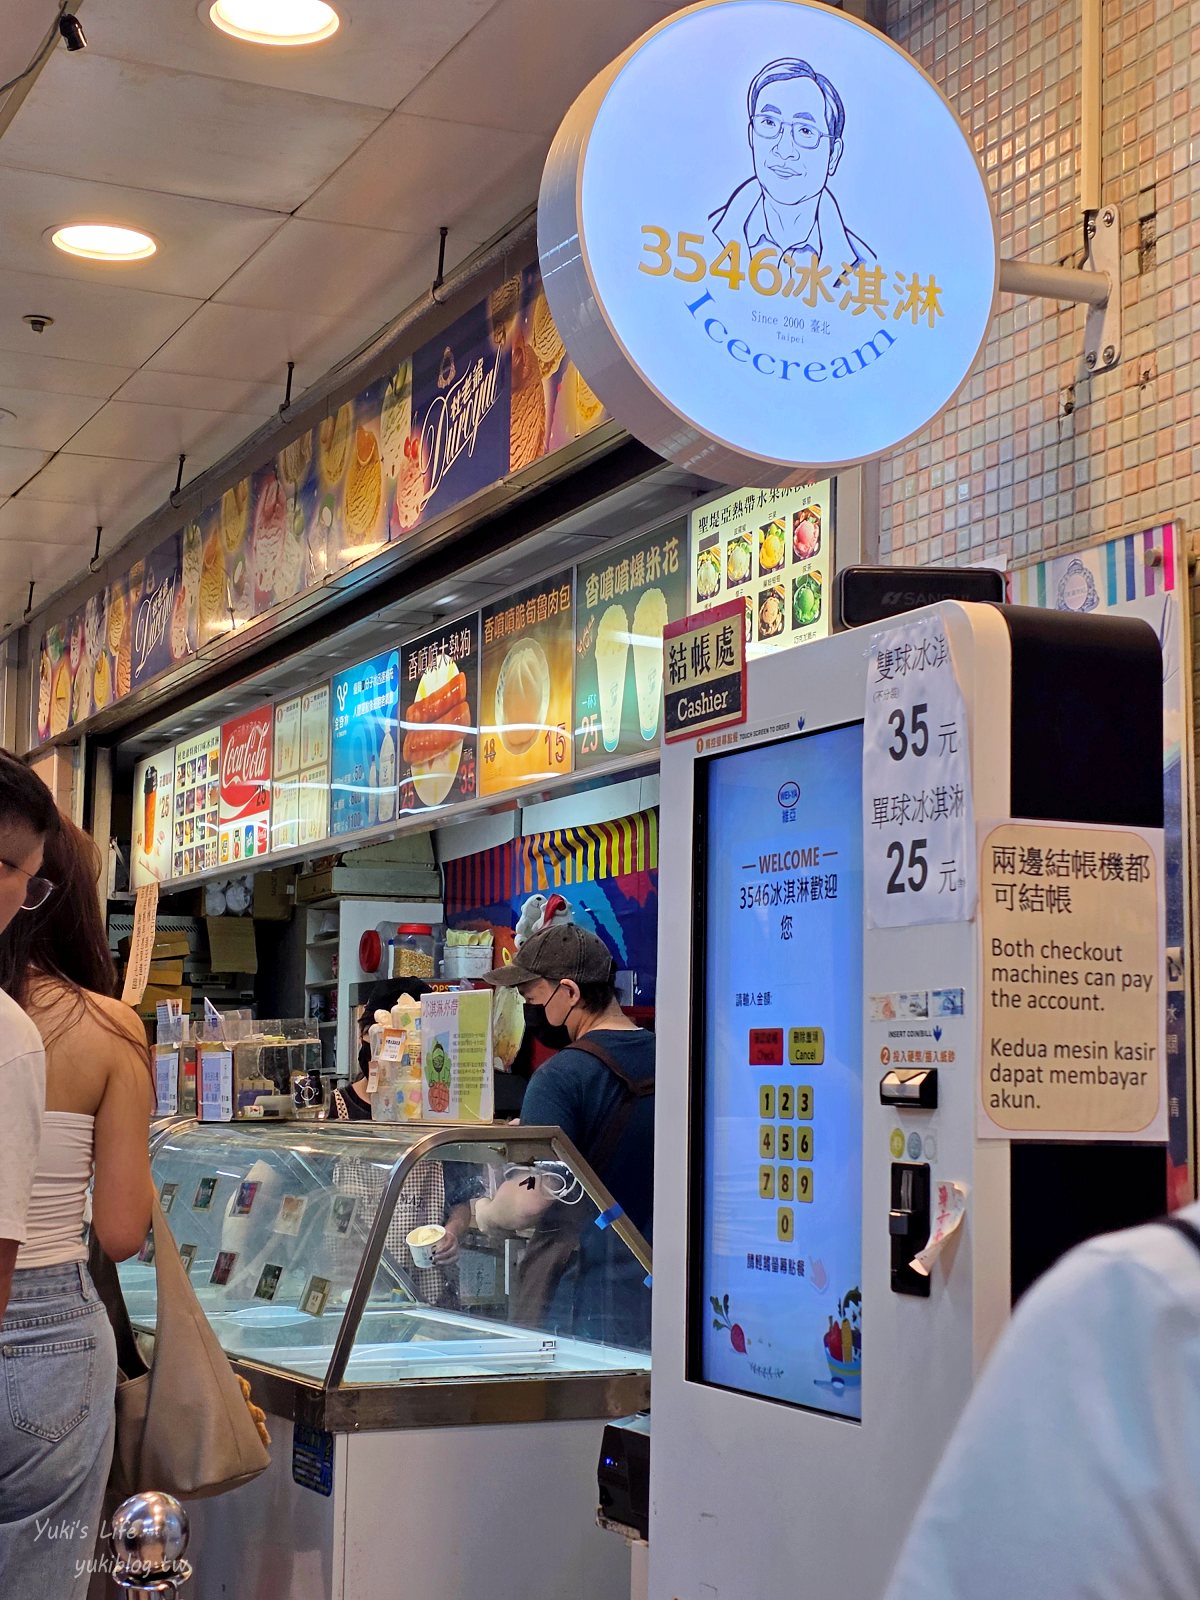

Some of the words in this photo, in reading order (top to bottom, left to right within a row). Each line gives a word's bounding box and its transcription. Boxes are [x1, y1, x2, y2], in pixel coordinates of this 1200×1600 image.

[638, 225, 944, 328] 3546冰淇淋
[751, 310, 778, 327] Since
[783, 315, 805, 331] 2000
[684, 288, 898, 383] Icecream
[776, 331, 805, 345] Taipei
[450, 357, 484, 422] 杜老爺
[585, 536, 679, 609] 香噴噴爆米花
[408, 627, 471, 681] 香噴噴大熱狗
[669, 625, 735, 685] 結帳處
[677, 690, 729, 721] Cashier
[581, 714, 598, 754] 25
[740, 732, 753, 740] TOUCH
[753, 728, 770, 737] SCREEN
[776, 722, 790, 732] ORDER
[888, 703, 929, 762] 35
[938, 722, 958, 757] 元
[545, 722, 567, 766] 15
[461, 760, 475, 794] 35
[759, 847, 820, 874] WELCOME
[886, 838, 928, 894] 25
[938, 860, 957, 894] 元
[991, 845, 1151, 883] 兩邊結帳機都
[739, 874, 838, 909] 3546冰淇淋歡迎
[992, 883, 1073, 914] 可結帳
[780, 915, 793, 941] 您
[992, 938, 1034, 959] Both
[1040, 941, 1123, 962] checkout
[991, 964, 1079, 985] machines
[1084, 970, 1115, 987] can
[1122, 972, 1153, 992] pay
[991, 988, 1022, 1009] the
[1027, 992, 1105, 1011] account.
[888, 1029, 906, 1039] INSERT
[795, 1047, 817, 1061] Cancel
[990, 1037, 1047, 1058] Kedua
[1054, 1041, 1108, 1061] mesin
[1114, 1040, 1156, 1061] kasir
[990, 1062, 1043, 1087] dapat
[1050, 1065, 1148, 1090] membayar
[765, 1093, 770, 1111] 1
[782, 1093, 789, 1111] 2
[801, 1093, 809, 1112] 3
[990, 1088, 1041, 1109] akun.
[763, 1132, 771, 1150] 4
[782, 1134, 789, 1152] 5
[801, 1135, 809, 1153] 6
[763, 1173, 770, 1191] 7
[781, 1174, 789, 1193] 8
[801, 1175, 809, 1195] 9
[781, 1215, 788, 1234] 0
